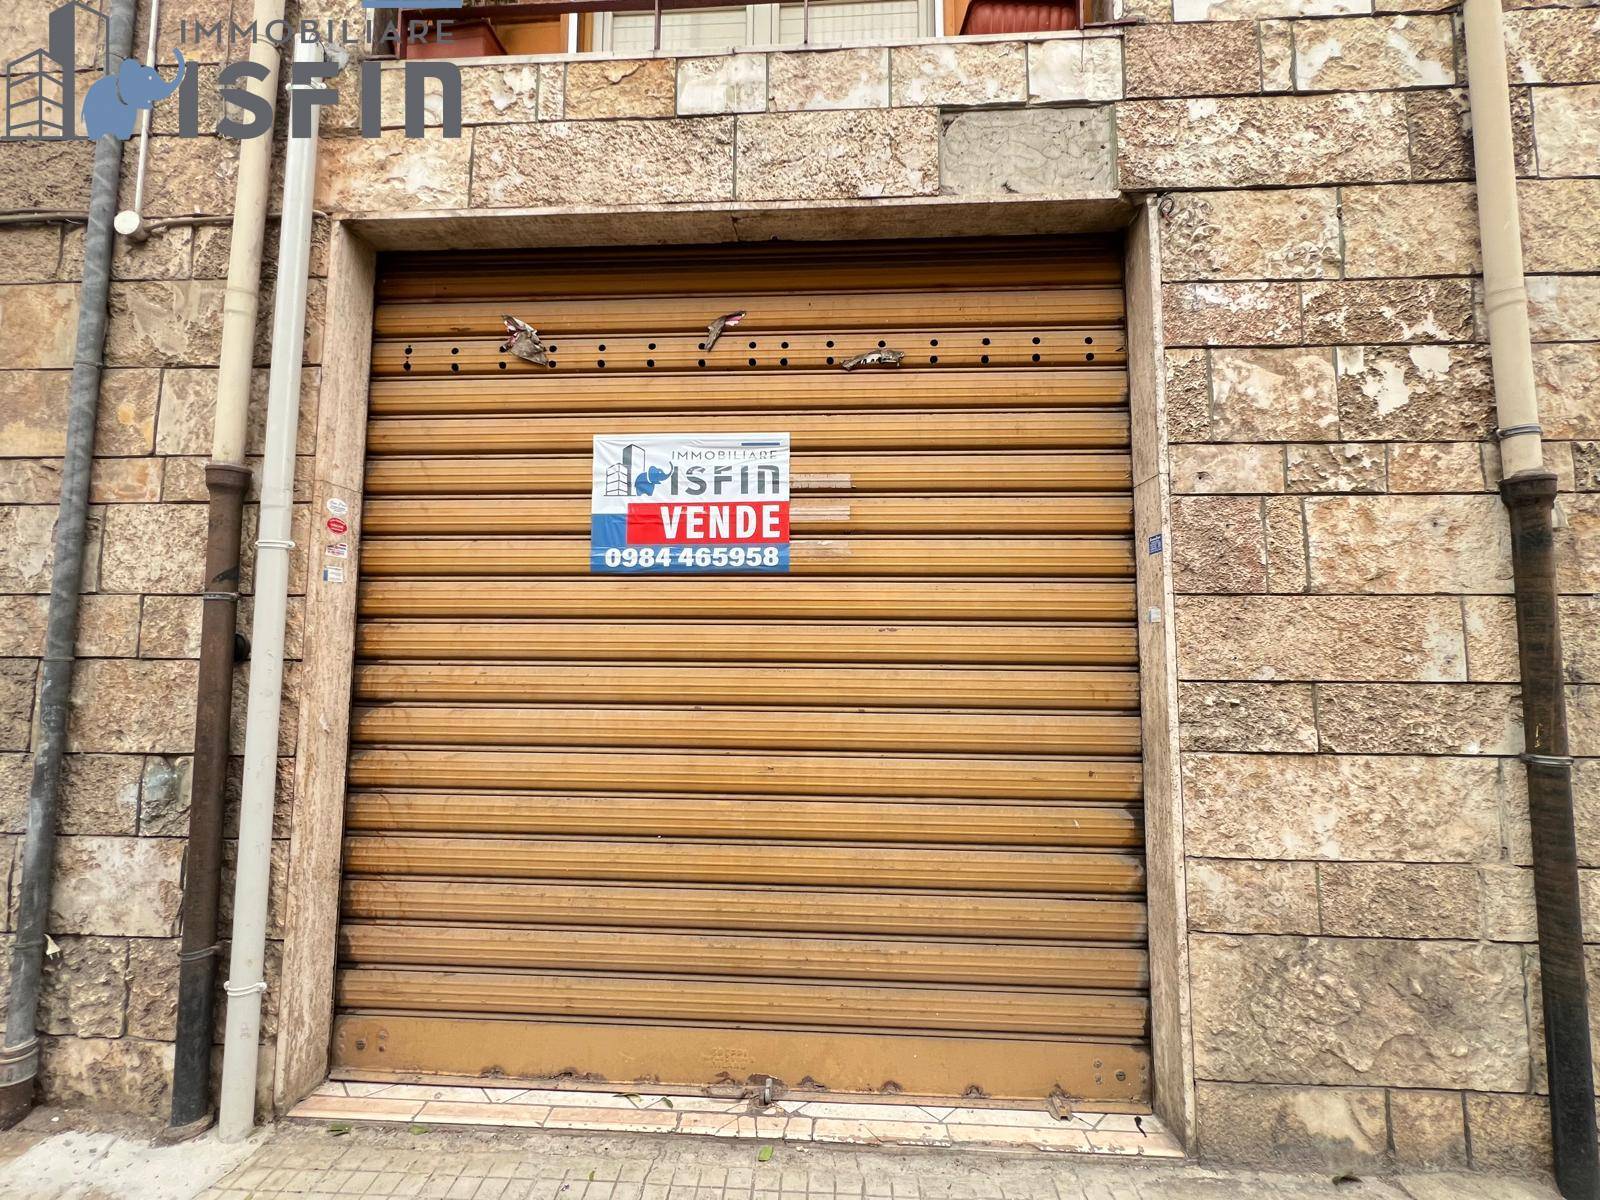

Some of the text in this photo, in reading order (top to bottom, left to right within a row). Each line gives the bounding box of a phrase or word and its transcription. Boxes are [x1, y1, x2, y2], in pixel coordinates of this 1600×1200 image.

[672, 450, 777, 461] IMMOBILIARE
[661, 504, 781, 539] VENDE
[605, 546, 779, 567] 0984 465958
